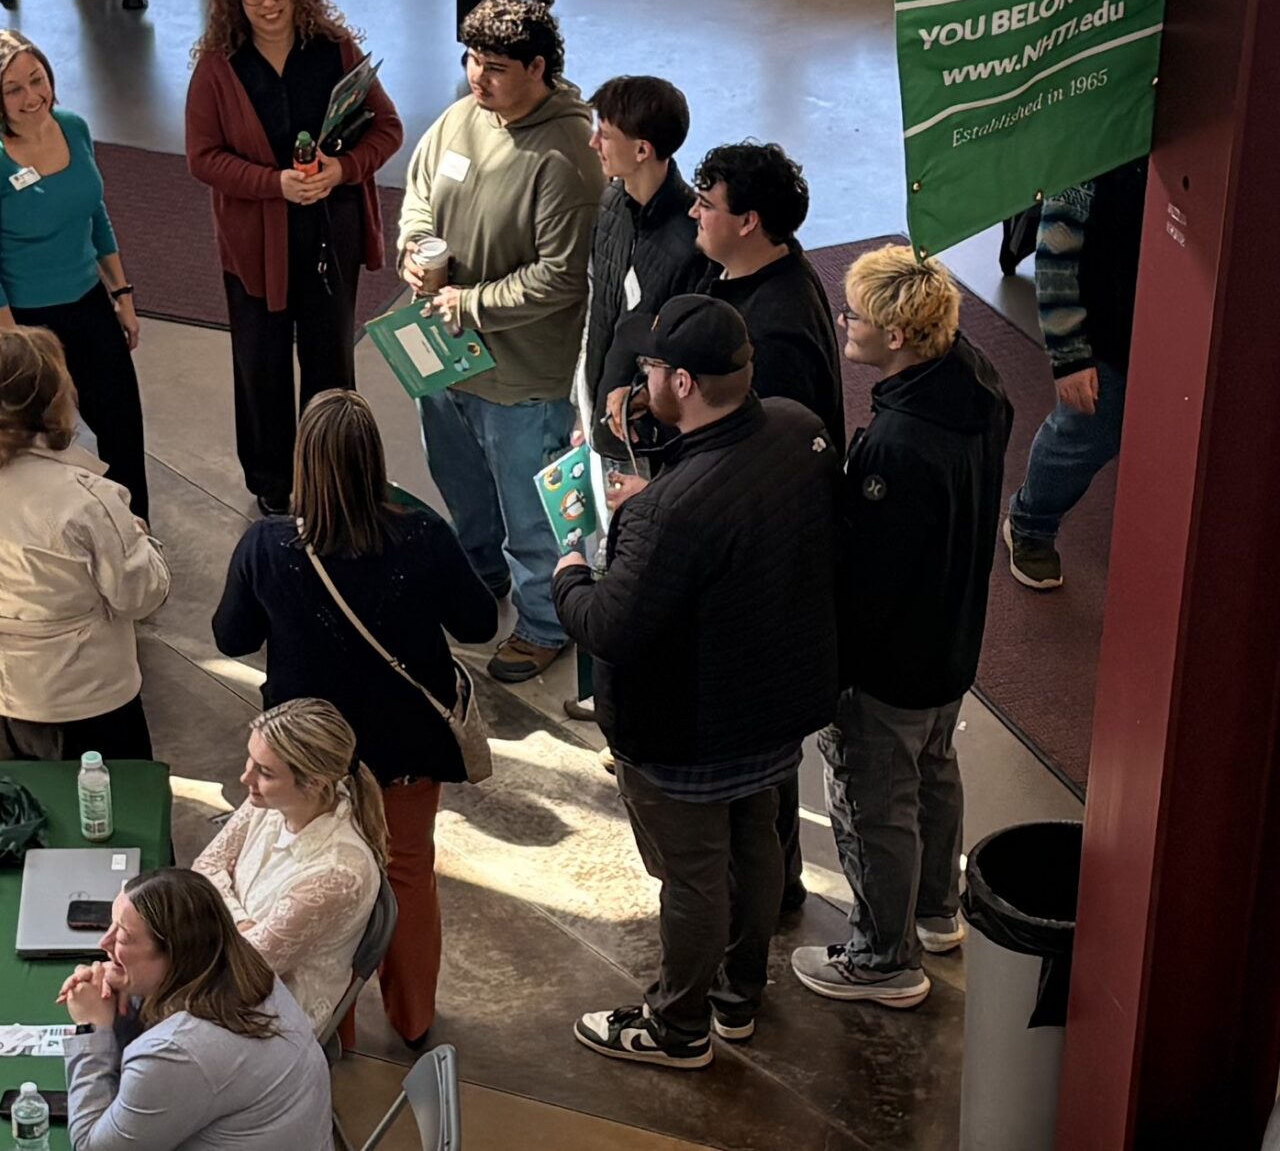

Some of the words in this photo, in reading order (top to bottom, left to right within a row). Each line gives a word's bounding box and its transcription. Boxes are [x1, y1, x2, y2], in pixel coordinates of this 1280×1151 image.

[918, 14, 985, 50] YOU
[942, 0, 1124, 86] www.NHTI.edu
[952, 94, 1043, 147] Established
[1047, 88, 1064, 105] in
[1070, 69, 1108, 97] 1965
